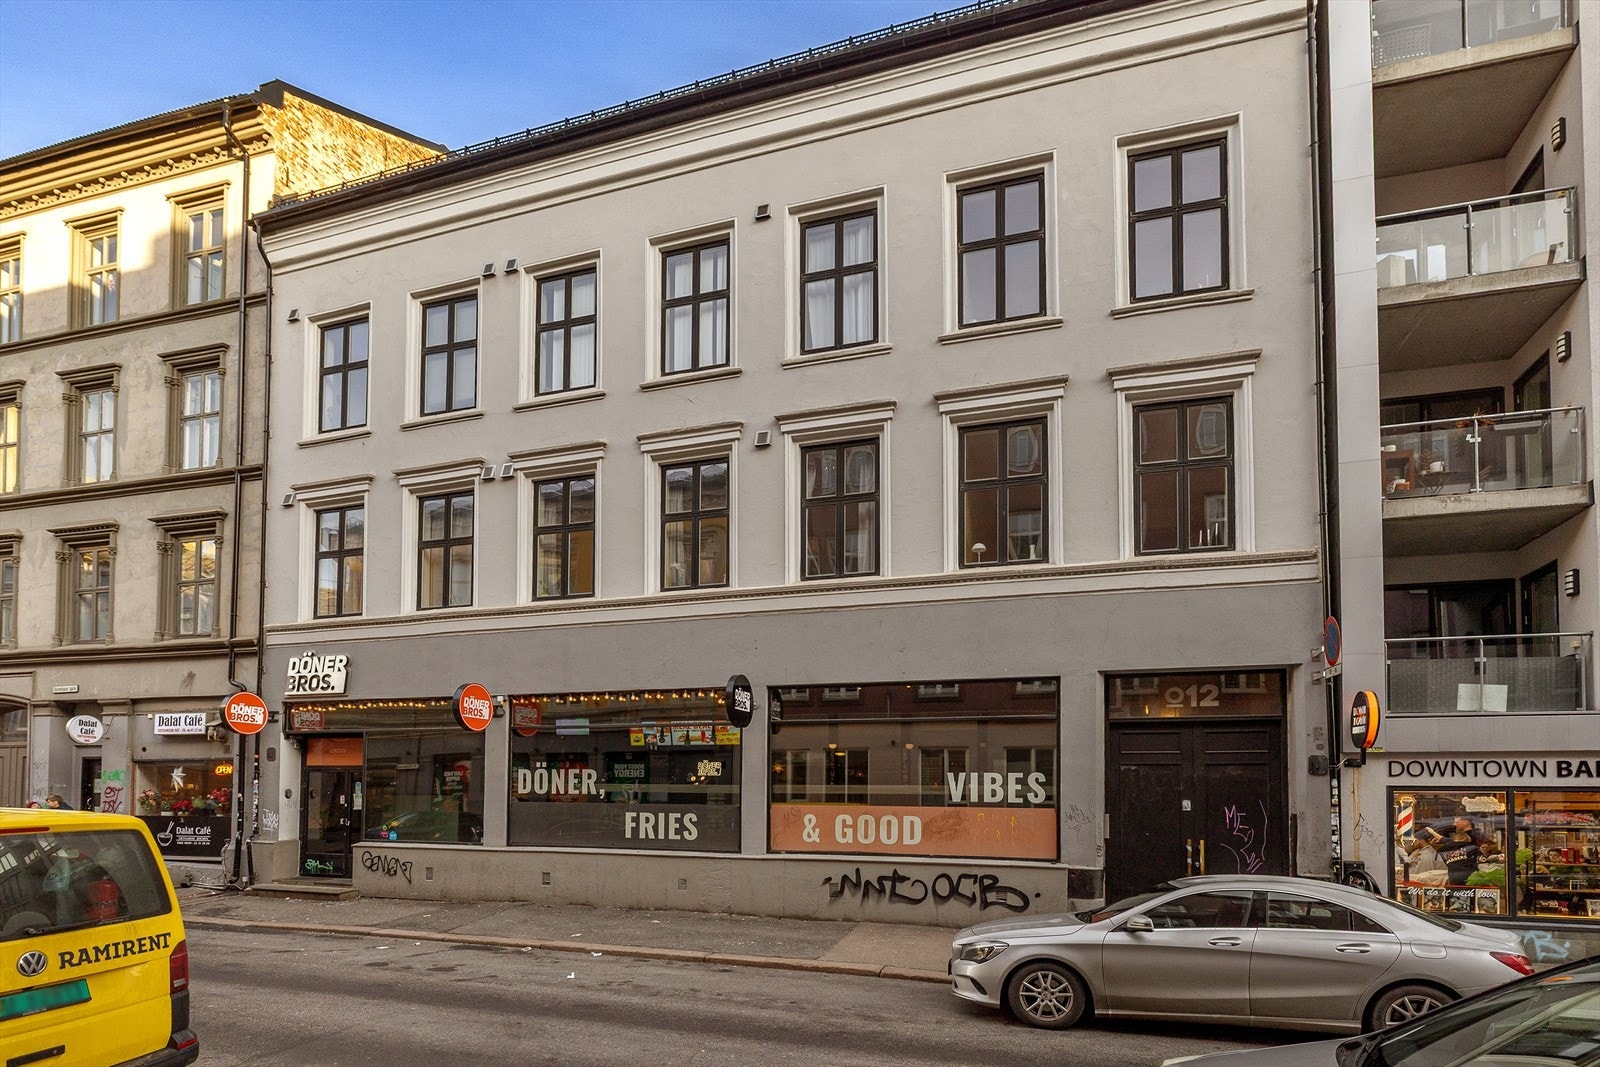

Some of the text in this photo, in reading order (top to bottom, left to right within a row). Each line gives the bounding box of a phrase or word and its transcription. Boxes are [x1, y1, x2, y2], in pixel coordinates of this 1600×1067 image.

[287, 651, 347, 674] DÖNER
[287, 673, 336, 692] BROS.
[230, 702, 265, 716] DÖNER
[463, 696, 490, 710] DÖNER
[230, 713, 258, 723] BROS.
[463, 706, 485, 718] BROS.
[78, 719, 98, 728] Dalat
[158, 714, 203, 727] Dalat Café
[80, 727, 96, 736] Café
[216, 765, 233, 775] OPEN
[1388, 760, 1600, 778] DOWNTOWN BA
[517, 762, 605, 799] DÖNER,
[947, 772, 1047, 804] VIBES
[176, 826, 211, 835] Dalat Café
[624, 812, 698, 841] FRIES
[802, 814, 922, 845] & GOOD
[1408, 887, 1497, 899] We do it with love
[58, 932, 171, 969] RAMIRENT
